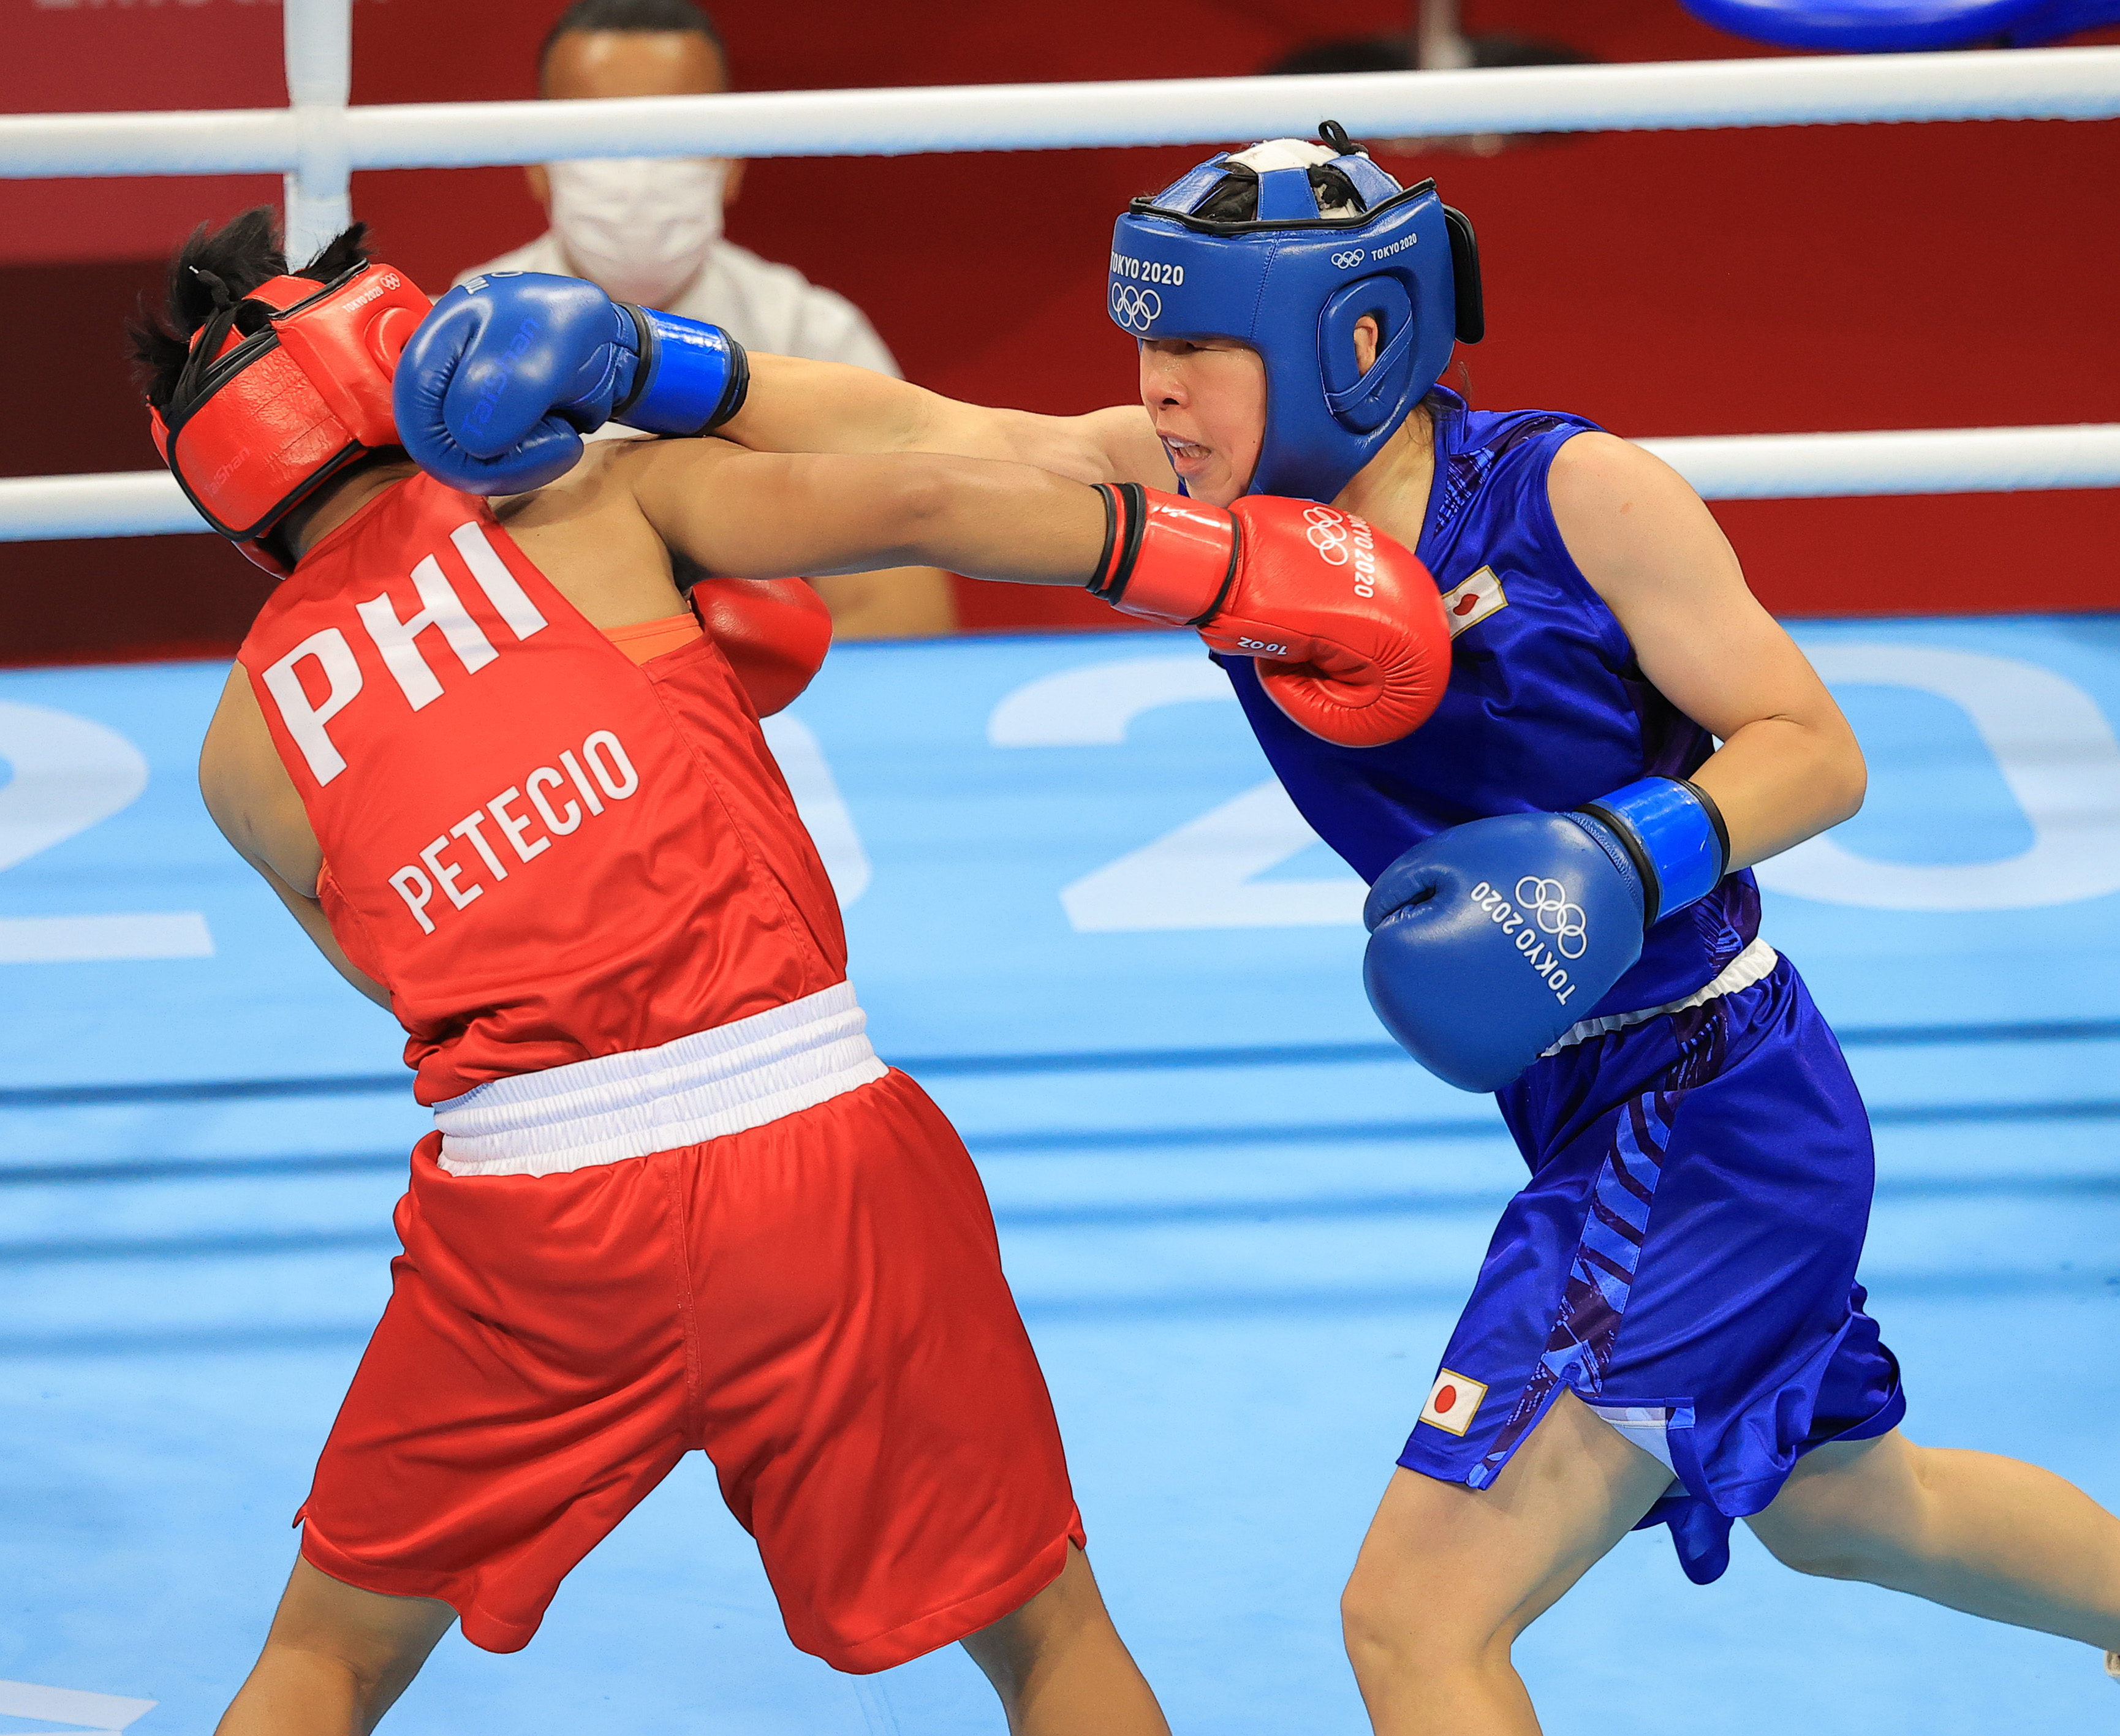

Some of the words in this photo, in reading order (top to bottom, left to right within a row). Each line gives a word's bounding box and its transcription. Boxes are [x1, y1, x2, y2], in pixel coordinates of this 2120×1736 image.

[1110, 251, 1140, 279] TOKYO
[1140, 260, 1184, 286] 2020
[1371, 242, 1400, 262] TOKYO
[1399, 232, 1418, 251] 2020
[342, 295, 368, 313] TOKYO
[365, 285, 385, 301] 2020
[1345, 511, 1374, 549] OKYO
[1354, 548, 1376, 598] 2020
[262, 520, 549, 788] PHI
[388, 730, 640, 936] PETECIO
[1471, 881, 1525, 935] 2020
[1515, 927, 1577, 1006] TOKYO
